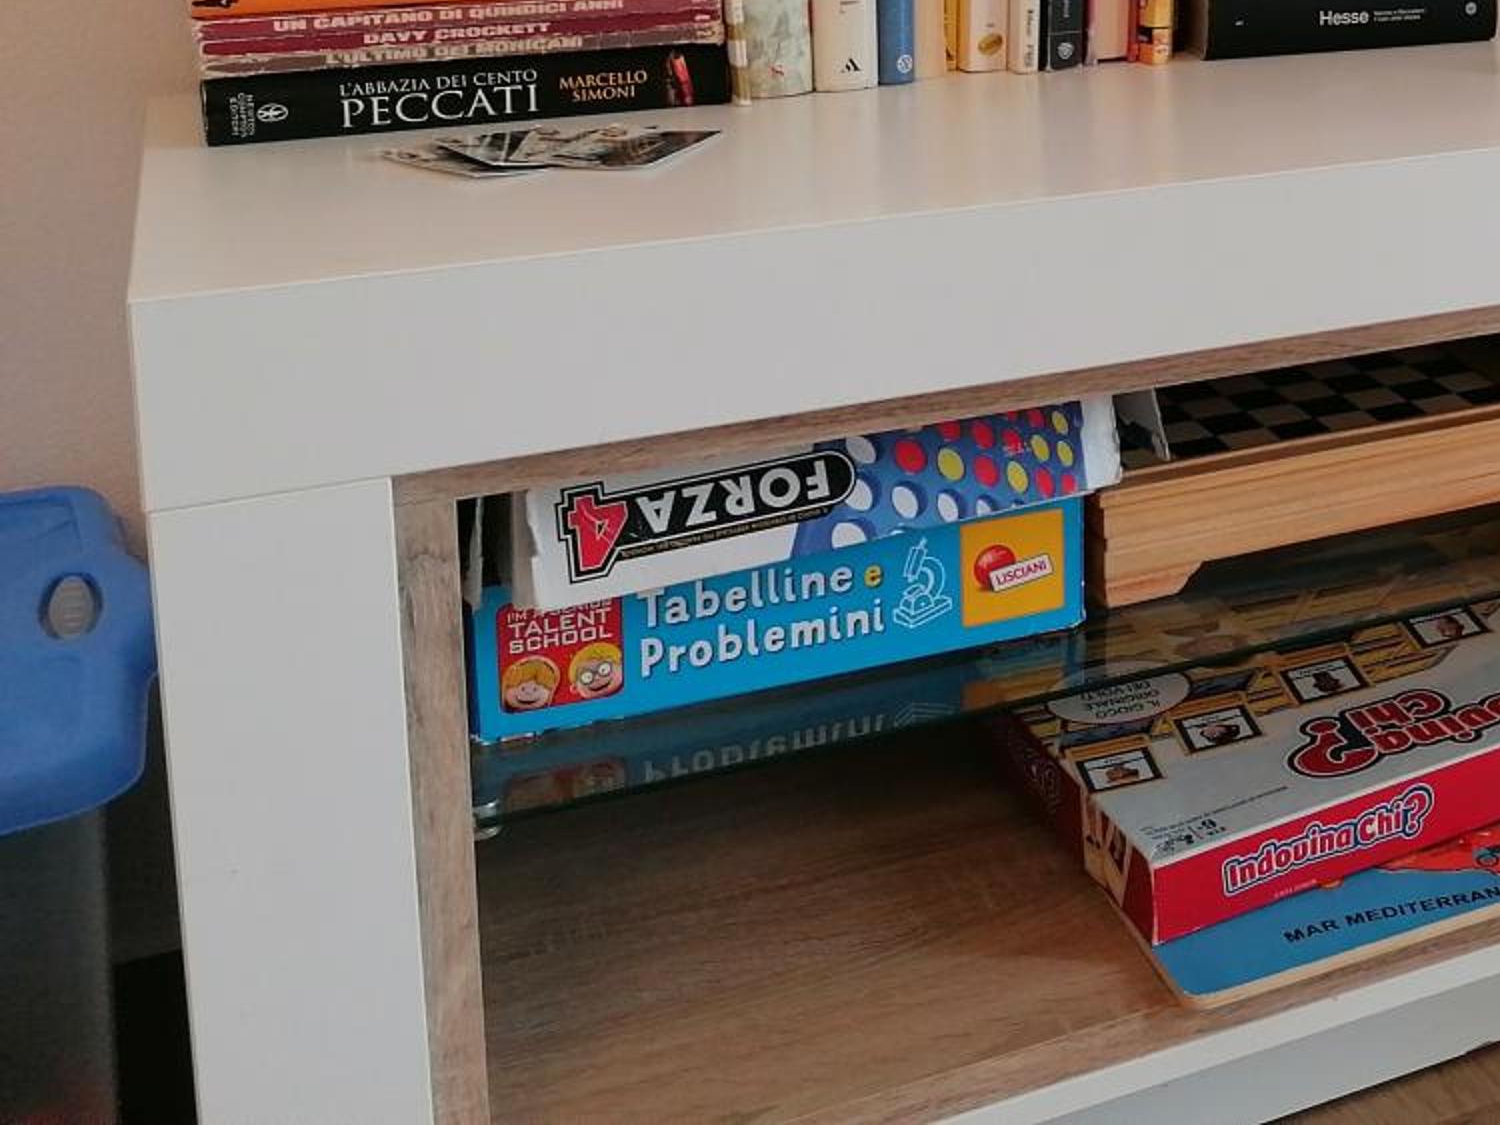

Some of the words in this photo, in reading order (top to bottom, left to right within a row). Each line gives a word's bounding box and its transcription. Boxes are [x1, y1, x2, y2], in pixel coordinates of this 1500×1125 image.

[273, 19, 307, 31] UN
[313, 11, 432, 29] CAPITANO
[439, 8, 463, 20] DI
[470, 3, 566, 19] QUINDICI
[572, 0, 624, 12] ANNI
[1319, 10, 1369, 25] Hesse
[363, 30, 428, 44] DAVY
[434, 22, 551, 42] CROCKETT
[325, 48, 427, 65] L'ULTIMO
[339, 78, 431, 96] L'ABBAZIA
[436, 74, 467, 90] DEI
[473, 68, 538, 86] CENTO
[559, 70, 648, 91] MARCELLO
[573, 85, 636, 102] SIMONI
[340, 84, 539, 128] PECCATI
[635, 459, 831, 534] FORZA
[568, 494, 628, 572] 4
[995, 560, 1047, 585] LISCIANI
[636, 565, 853, 628] Tabelline
[864, 565, 884, 588] e
[507, 607, 612, 639] TALENT
[640, 599, 885, 677] Problemini
[509, 625, 613, 654] SCHOOL
[1292, 691, 1446, 776] Chi?
[1224, 823, 1355, 894] Indovina
[1358, 783, 1434, 840] Chi?
[1284, 919, 1340, 943] MAR
